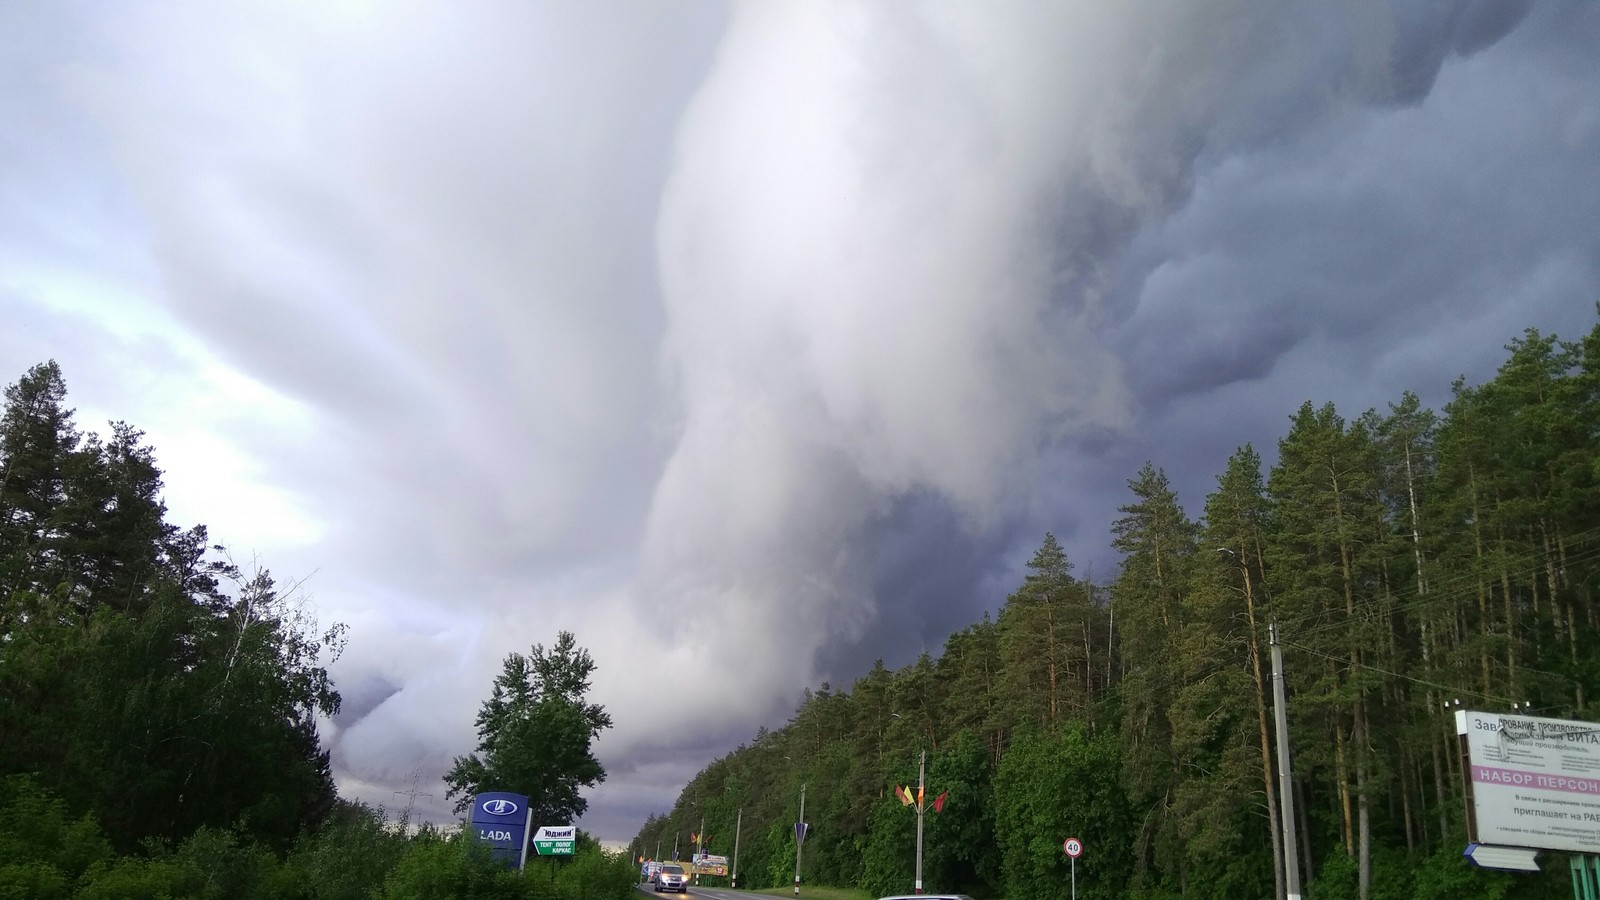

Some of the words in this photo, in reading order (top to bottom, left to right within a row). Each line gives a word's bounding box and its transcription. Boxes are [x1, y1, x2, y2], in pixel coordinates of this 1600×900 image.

[1475, 718, 1498, 731] Зав
[1480, 769, 1533, 785] НАБОР
[1538, 776, 1600, 793] ПЕРСОН
[1513, 807, 1568, 819] приглашает
[1570, 812, 1582, 821] на
[480, 829, 511, 841] LADA
[1067, 843, 1079, 852] 40
